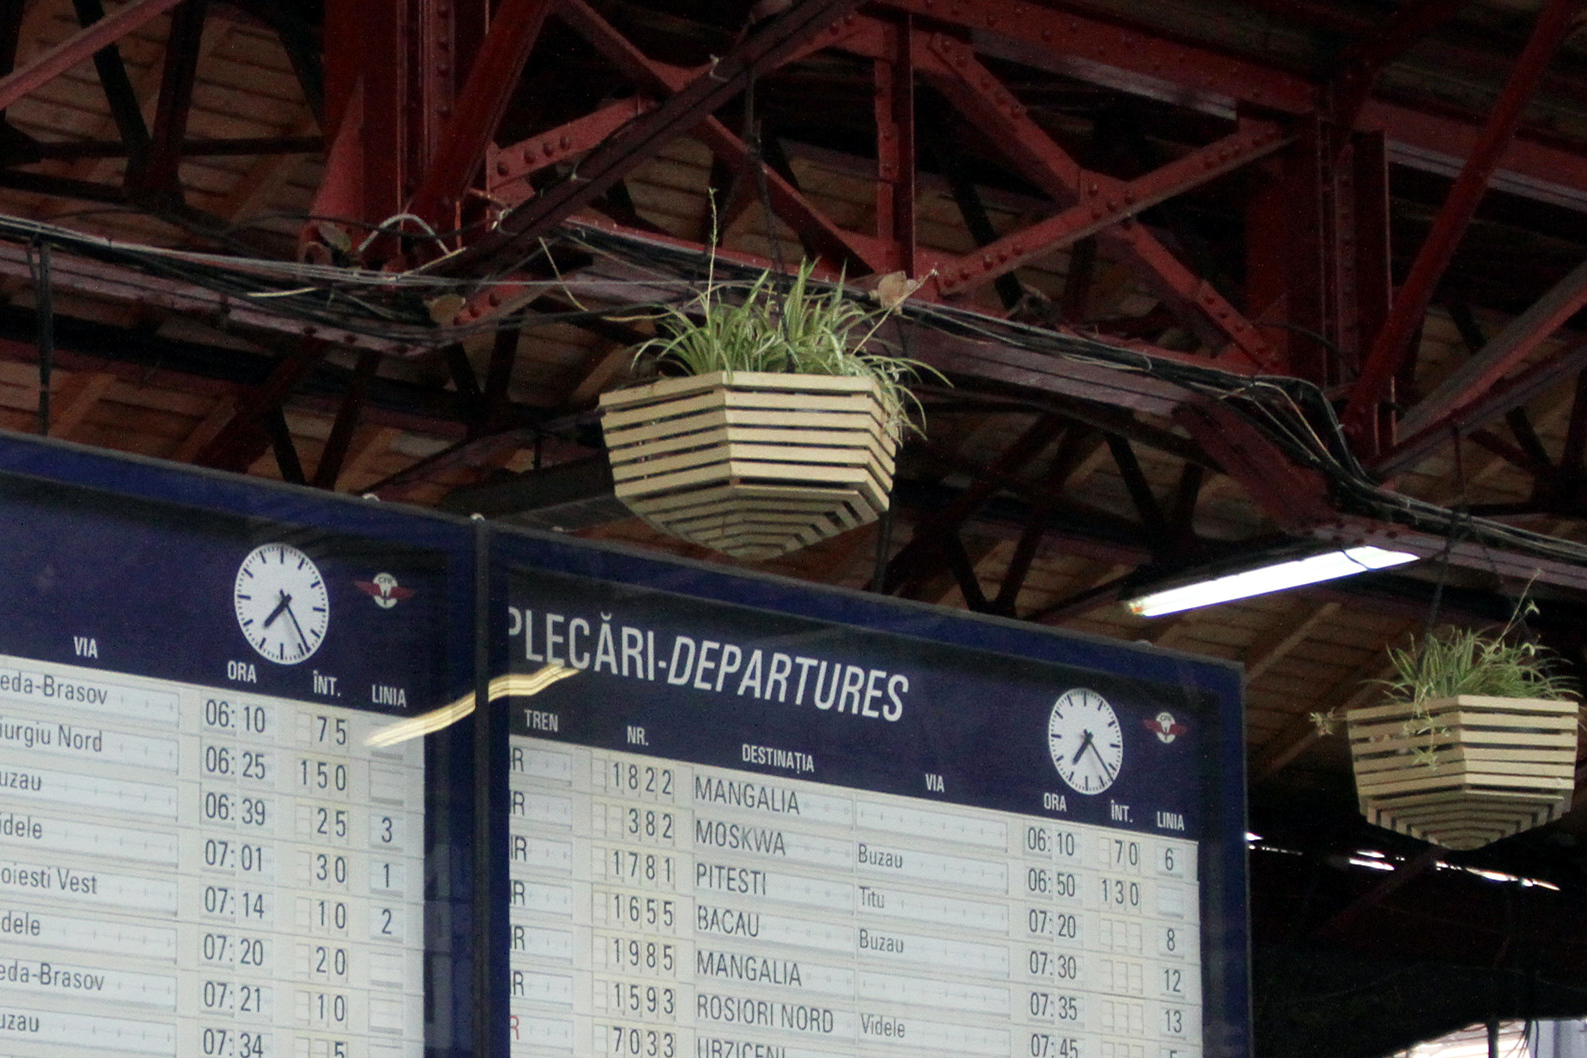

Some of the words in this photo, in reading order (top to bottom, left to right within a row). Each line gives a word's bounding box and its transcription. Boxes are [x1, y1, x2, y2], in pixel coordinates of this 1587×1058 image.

[73, 636, 98, 658] VIA
[228, 660, 257, 683] ORA
[372, 685, 407, 708] LINIA
[59, 724, 103, 753] Nord
[300, 759, 347, 792] 150
[317, 716, 347, 745] 75
[525, 709, 558, 732] TREN
[627, 726, 649, 746] NR.
[925, 773, 945, 793] VIA
[1044, 792, 1067, 813] ORA
[1157, 811, 1184, 831] LINIA
[317, 808, 346, 837] 25
[381, 816, 393, 844] 3
[613, 762, 673, 795] 1822
[695, 776, 800, 815] MANGALIA
[1115, 839, 1138, 866] 70
[1165, 848, 1174, 871] 6
[316, 854, 346, 883] 30
[382, 863, 389, 888] 1
[628, 808, 673, 839] 382
[696, 819, 786, 856] MOSKWA
[858, 844, 903, 869] Buzau
[1102, 879, 1139, 906] 130
[58, 868, 98, 894] Vest
[318, 900, 346, 929] 10
[381, 909, 392, 935] 2
[613, 851, 672, 882] 1781
[696, 862, 766, 896] PITESTI
[859, 885, 885, 909] Titu
[1166, 929, 1176, 952] 8
[316, 946, 346, 976] 20
[613, 895, 673, 926] 1655
[698, 905, 760, 937] BACAU
[859, 929, 904, 953] Buzau
[1164, 969, 1181, 993] 12
[318, 994, 345, 1022] 10
[613, 938, 674, 971] 1985
[697, 950, 802, 987] MANGALIA
[1165, 1009, 1182, 1034] 13
[613, 983, 674, 1015] 1593
[697, 994, 774, 1027] ROSIORI
[781, 1004, 834, 1033] NORD
[860, 1013, 905, 1038] Videle
[613, 1026, 674, 1058] 7033
